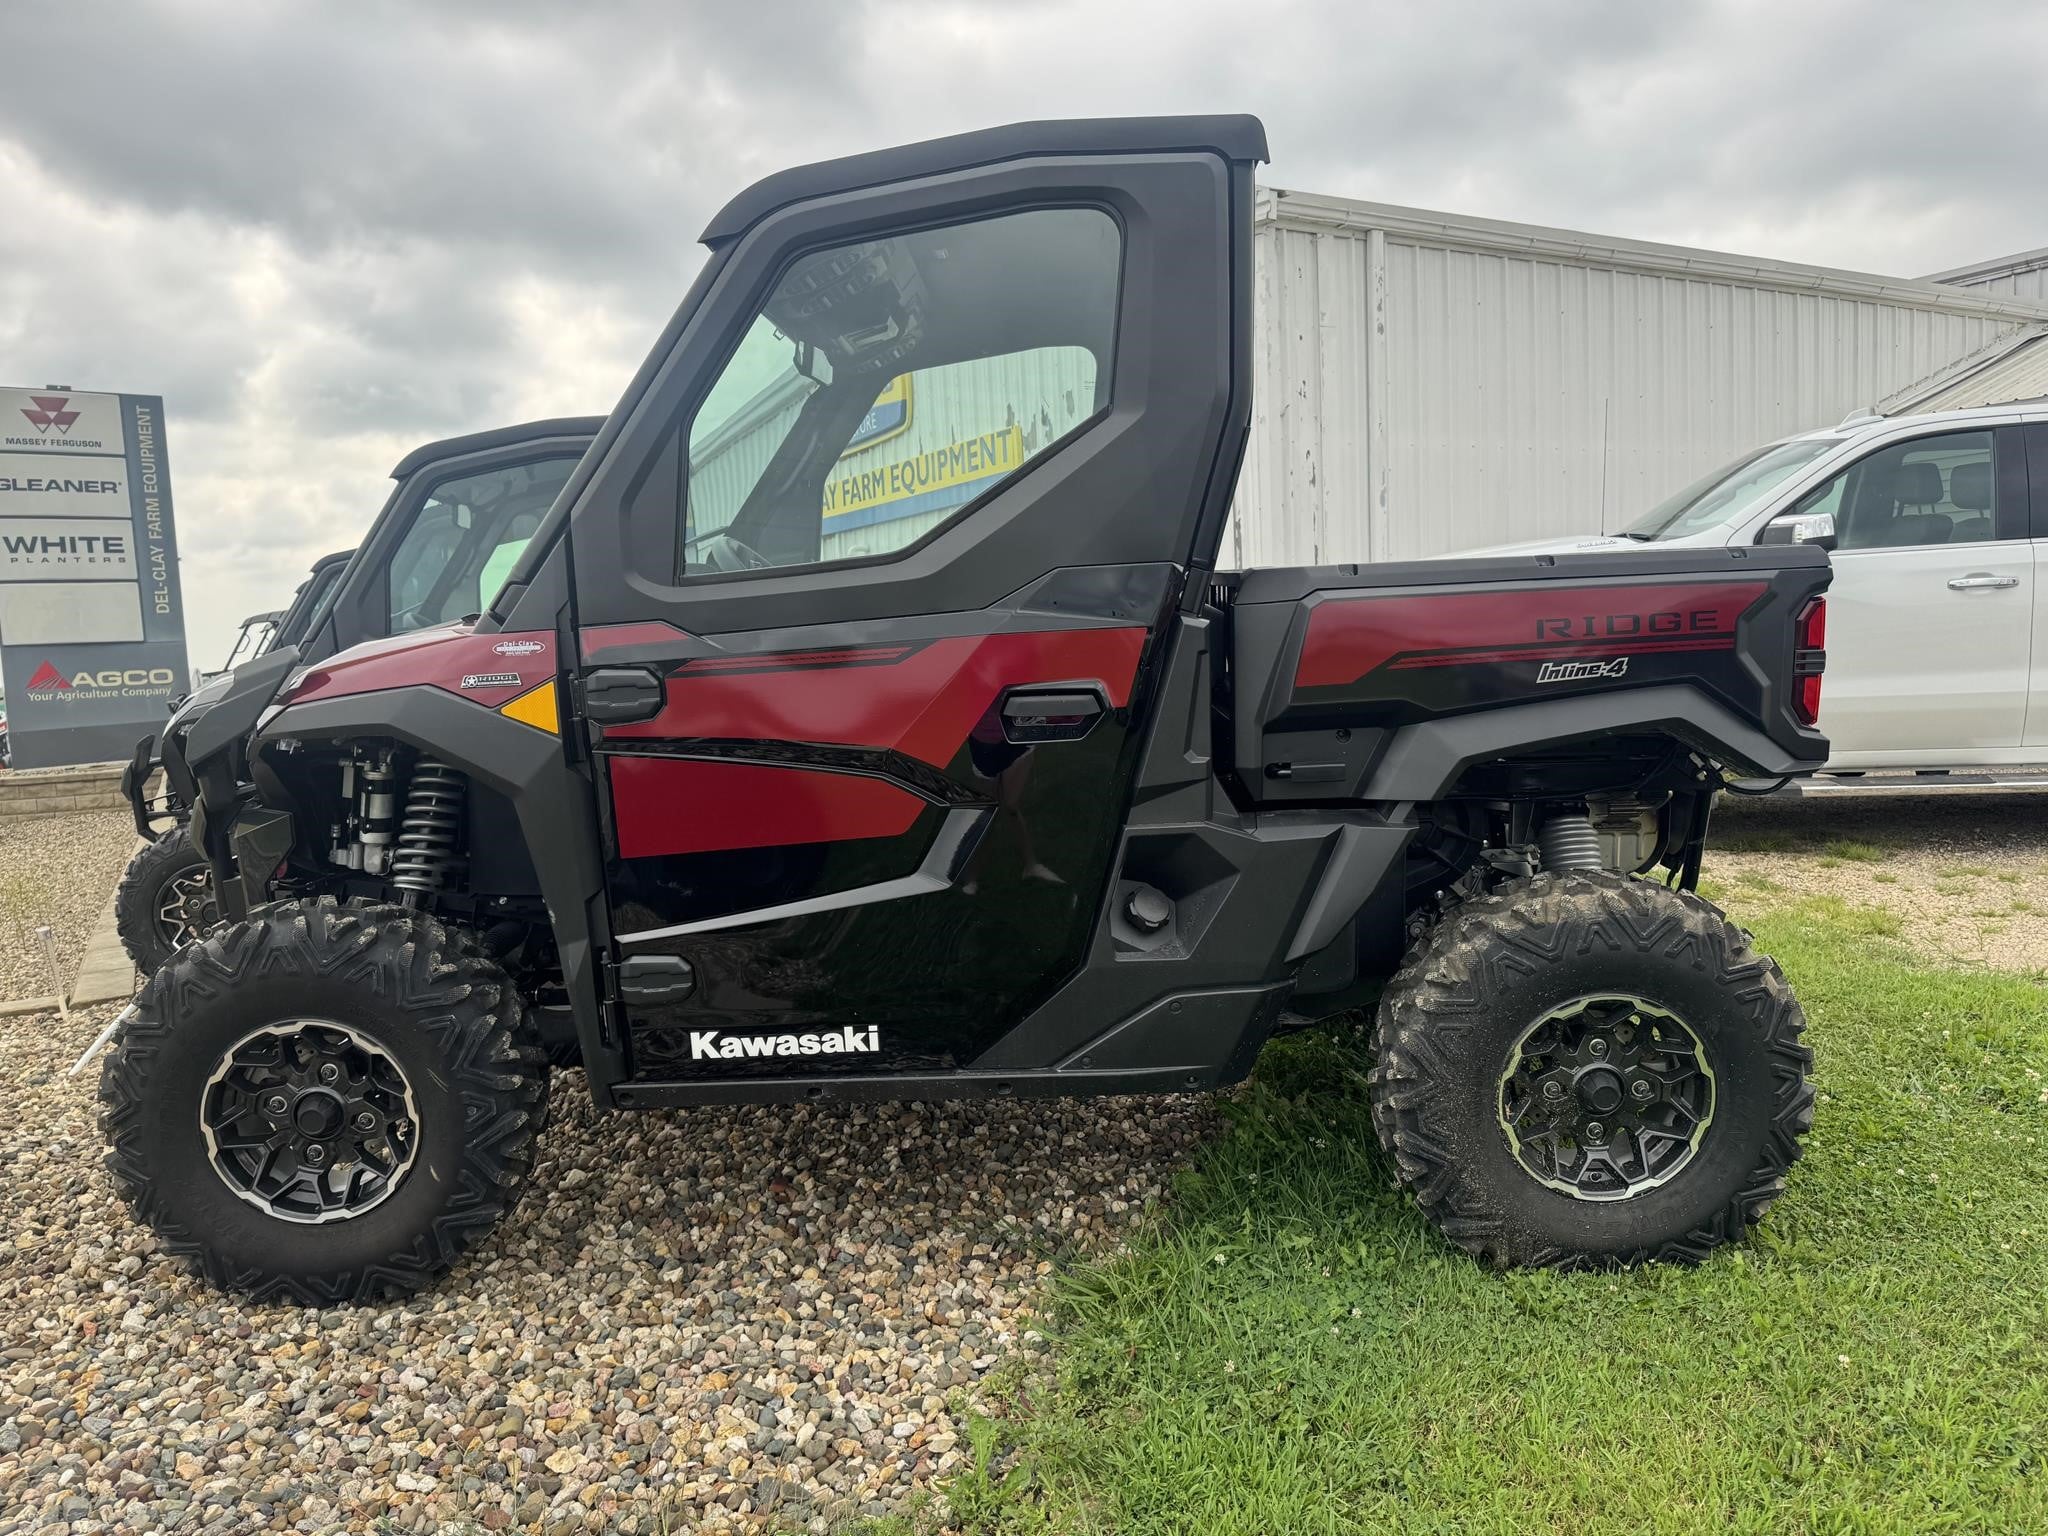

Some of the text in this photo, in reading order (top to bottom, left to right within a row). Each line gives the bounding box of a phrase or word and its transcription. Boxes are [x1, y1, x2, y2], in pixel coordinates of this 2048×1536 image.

[5, 437, 102, 448] MASSEY FERGUSON
[842, 470, 885, 507] FARM
[890, 428, 1012, 495] EQUIPMENT
[0, 478, 118, 494] GLEANER
[135, 405, 170, 614] DEL-CLAY FARM EQUIPMENT
[3, 536, 125, 554] WHITE
[1536, 610, 1718, 640] RIDGE
[71, 668, 174, 688] AGCO
[479, 674, 517, 682] RIDGE
[1536, 657, 1629, 684] Inline-4
[27, 687, 173, 702] Your Agriculture Company
[690, 1025, 880, 1060] Kawasaki
